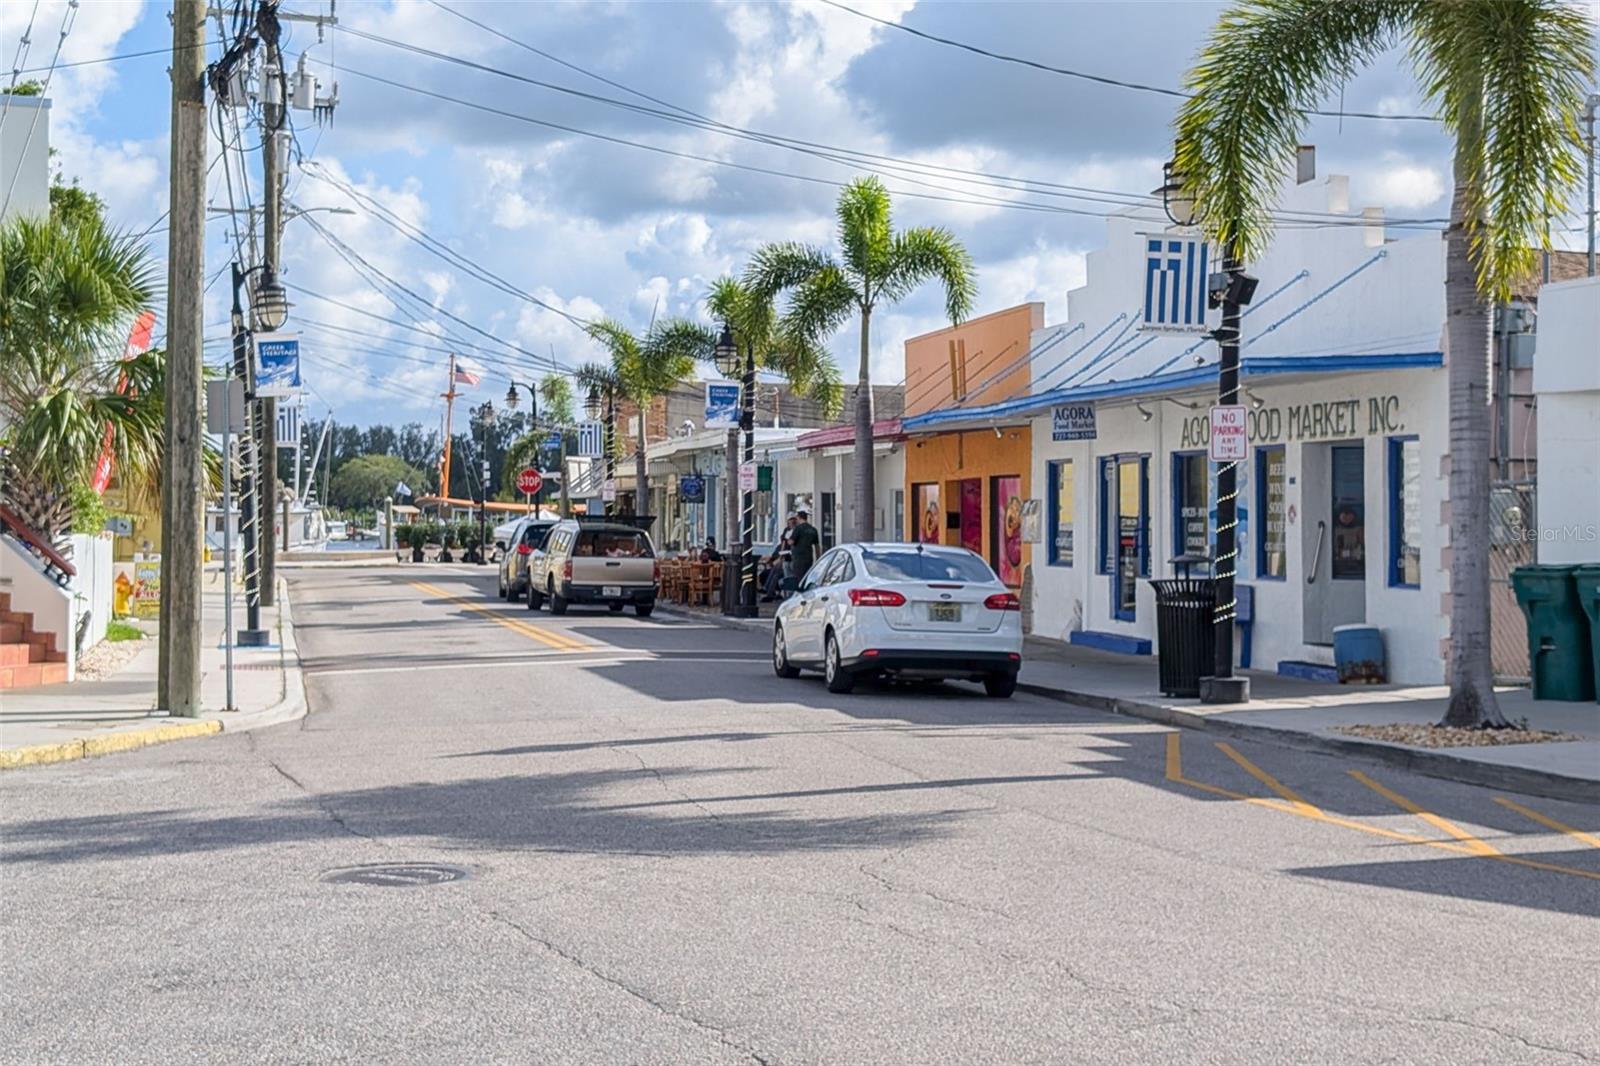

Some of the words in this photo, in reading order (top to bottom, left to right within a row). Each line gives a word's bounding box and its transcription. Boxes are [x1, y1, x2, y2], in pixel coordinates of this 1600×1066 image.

[1054, 406, 1094, 421] AGORA
[1221, 412, 1236, 424] NO
[1054, 420, 1070, 430] Food
[1071, 420, 1095, 429] Market
[1181, 416, 1209, 448] AGO
[1248, 408, 1281, 441] OOD
[1288, 401, 1360, 438] MARKET
[1368, 395, 1405, 434] INC.
[1212, 425, 1245, 436] PARKING
[1221, 437, 1237, 445] ANY
[1220, 446, 1238, 454] TIME
[519, 475, 541, 487] STOP
